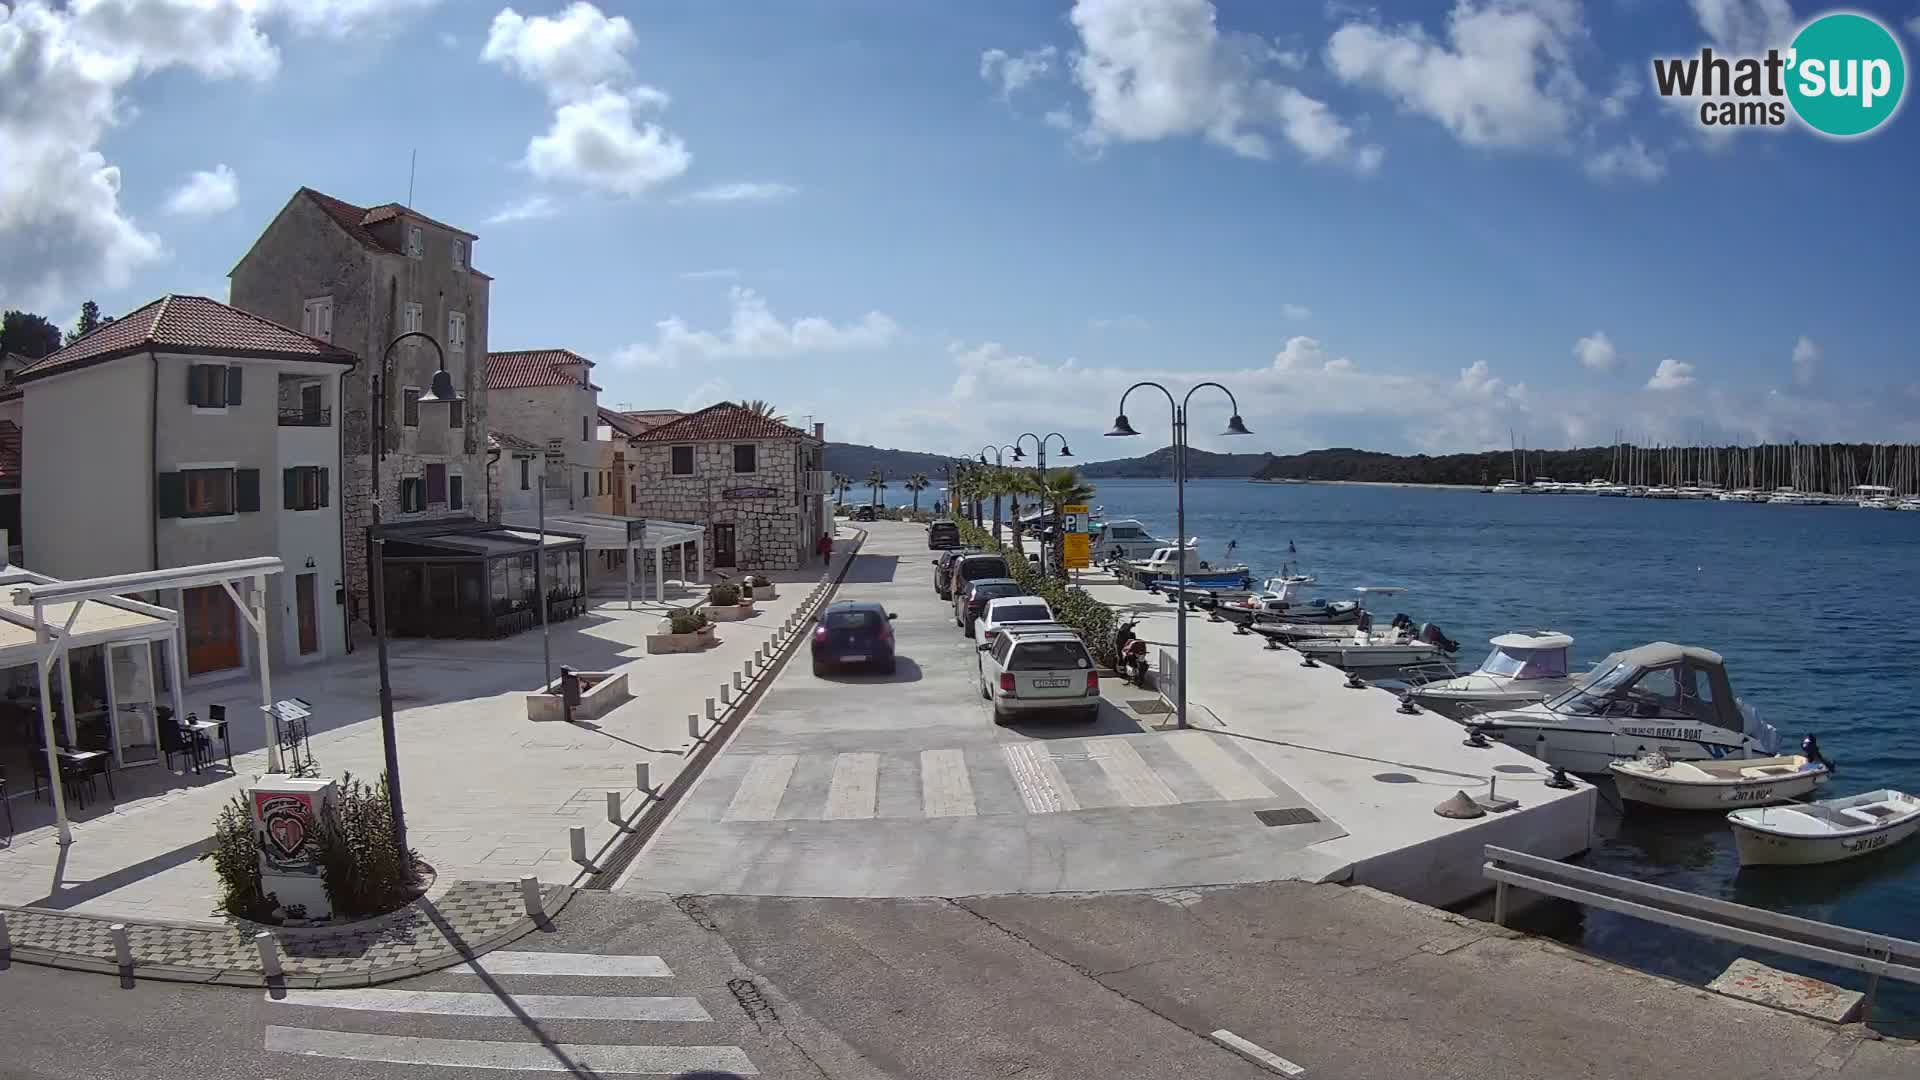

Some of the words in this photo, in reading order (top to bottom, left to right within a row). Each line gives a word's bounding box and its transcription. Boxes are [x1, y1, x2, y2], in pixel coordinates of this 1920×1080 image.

[1065, 515, 1076, 531] P
[1656, 728, 1677, 738] RENT
[1677, 728, 1682, 738] A
[1683, 729, 1702, 740] BOAT
